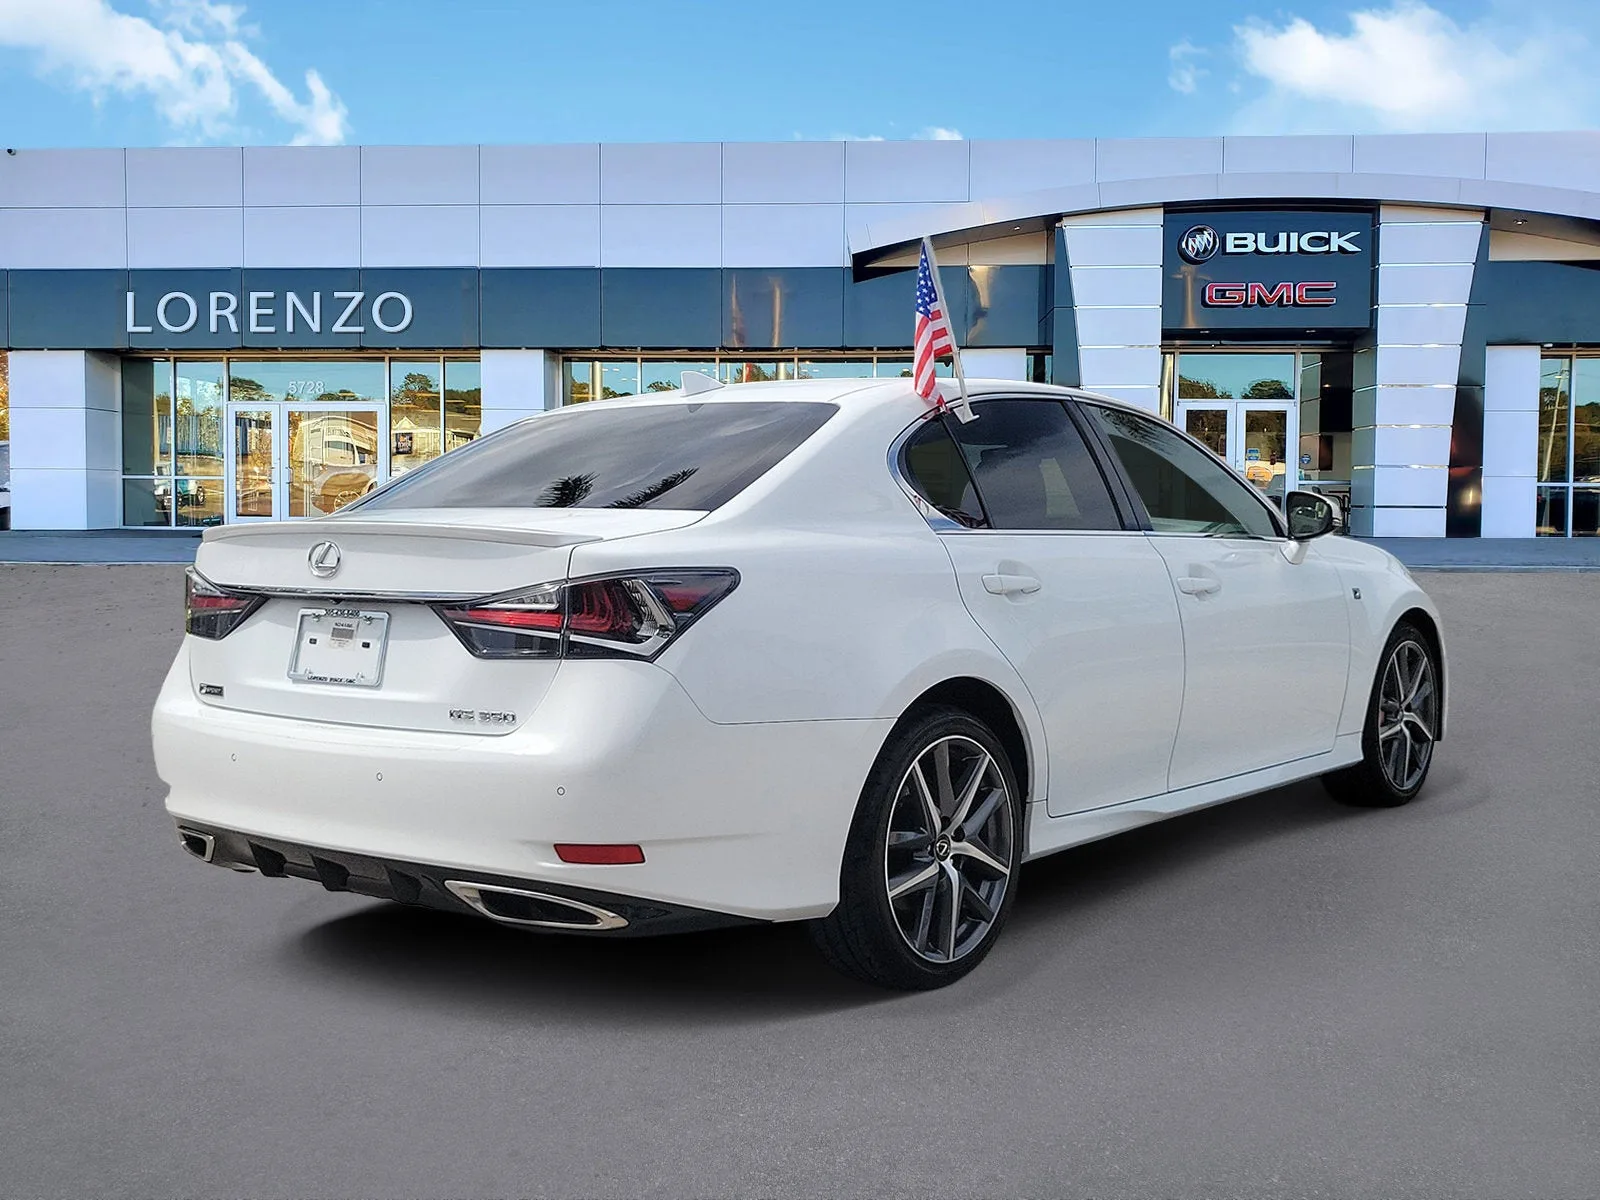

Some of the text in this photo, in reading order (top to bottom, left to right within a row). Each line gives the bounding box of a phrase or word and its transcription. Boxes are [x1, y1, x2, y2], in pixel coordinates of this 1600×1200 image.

[1225, 231, 1362, 252] BUICK
[1206, 281, 1337, 305] GMC
[126, 291, 413, 333] LORENZO
[288, 380, 326, 395] 5728
[449, 709, 516, 723] GS 350
